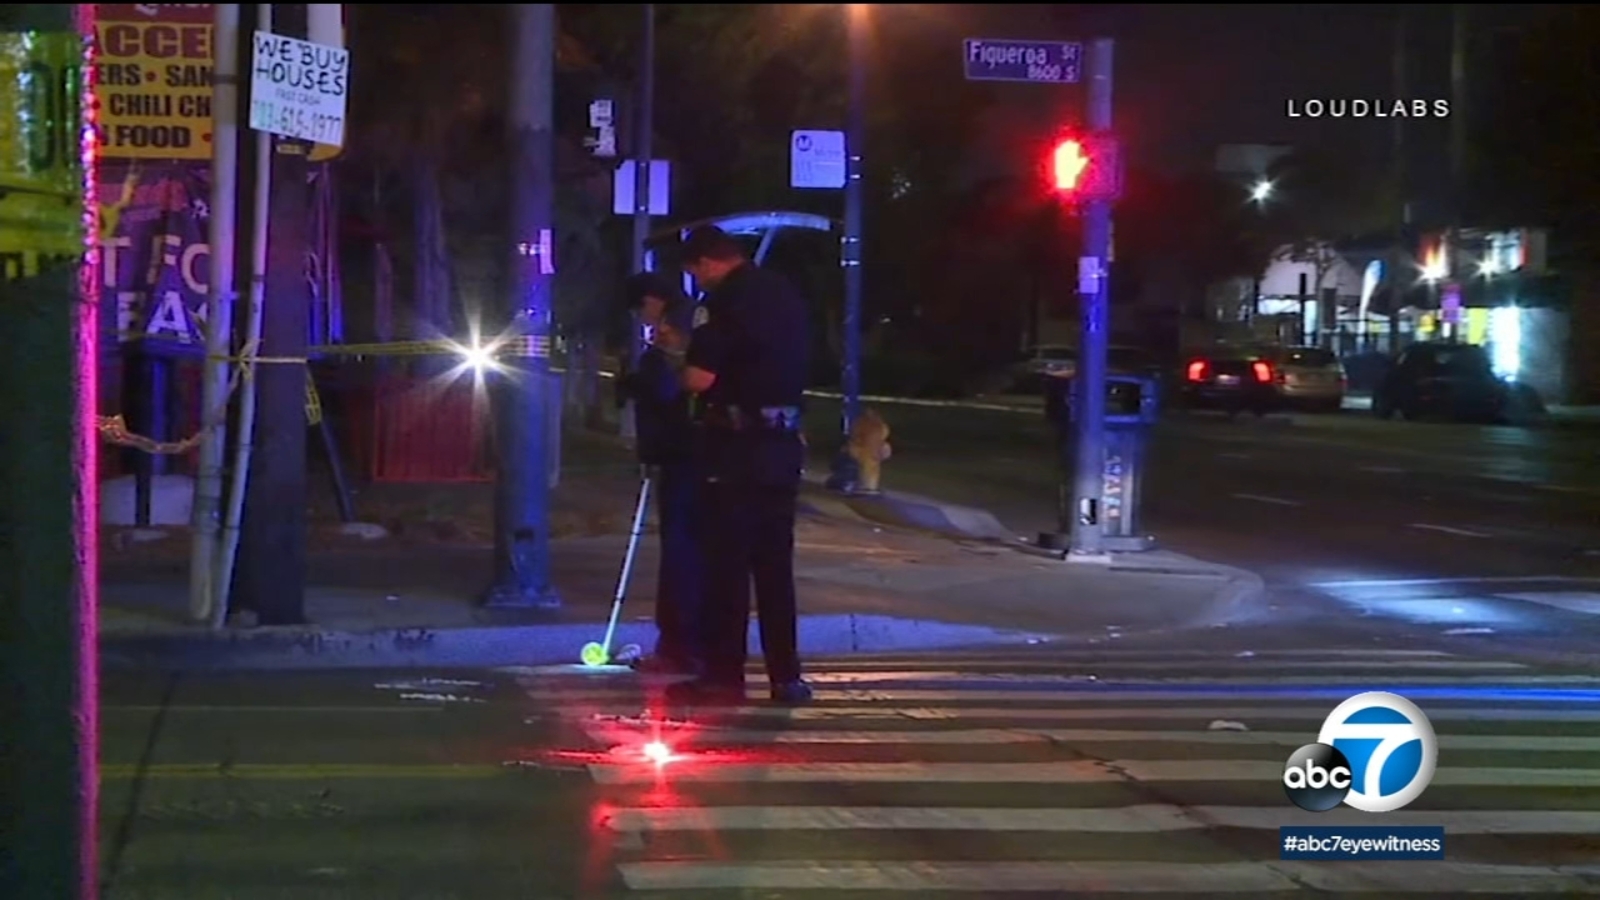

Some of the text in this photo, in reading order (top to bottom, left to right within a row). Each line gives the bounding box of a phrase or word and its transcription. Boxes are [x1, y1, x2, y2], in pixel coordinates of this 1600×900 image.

[256, 36, 345, 74] WE BUY
[970, 41, 1047, 69] Figueroa
[256, 58, 344, 96] HOUSES
[115, 125, 191, 149] FOOD
